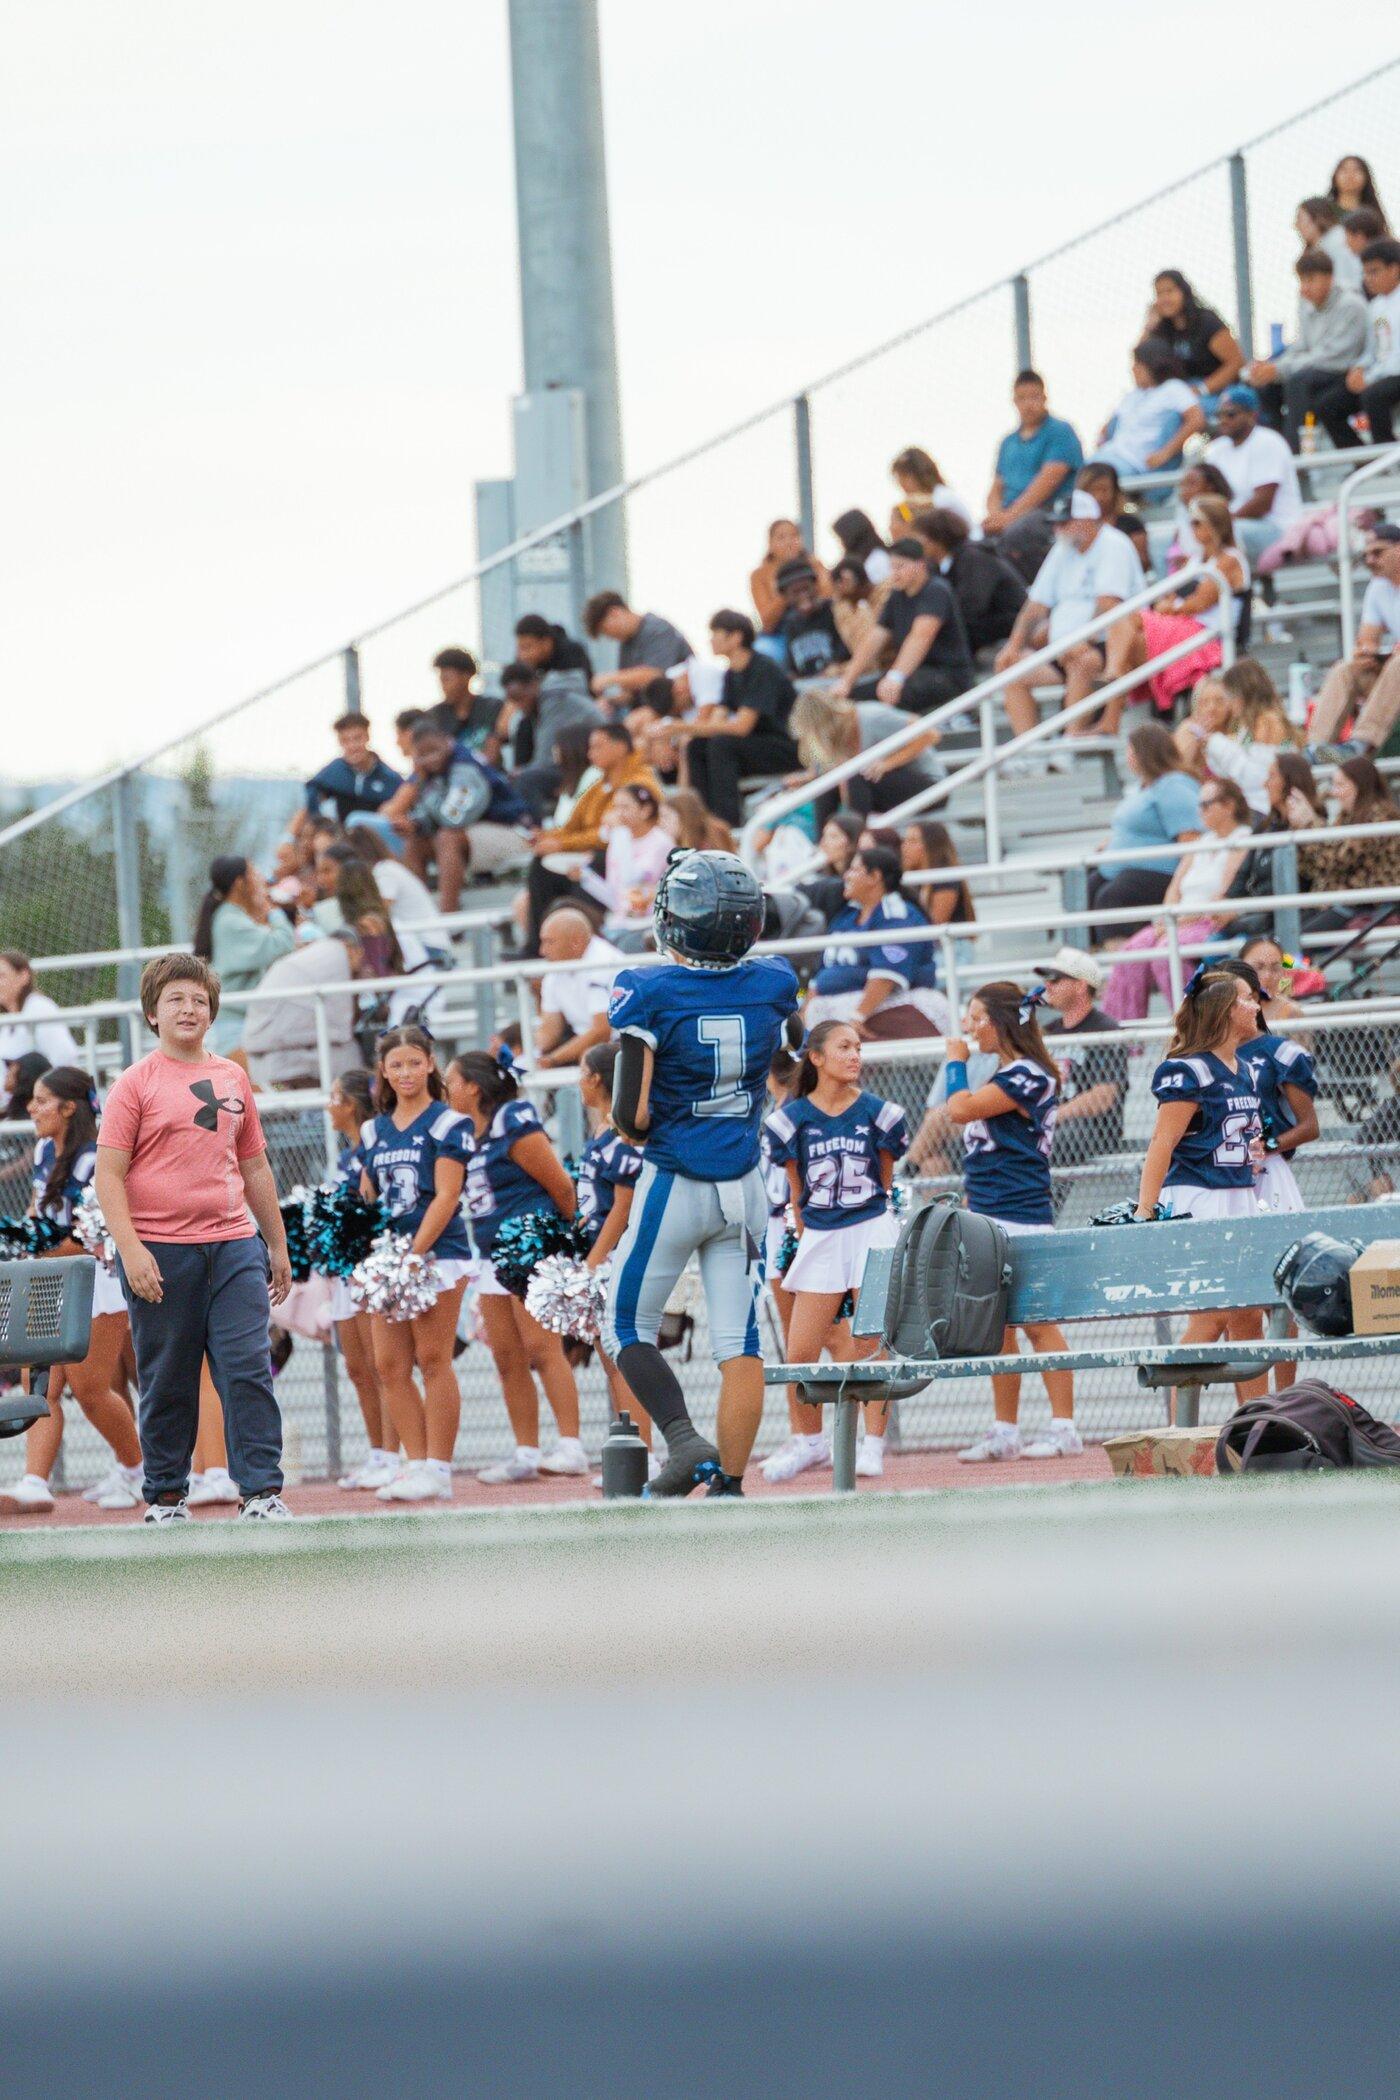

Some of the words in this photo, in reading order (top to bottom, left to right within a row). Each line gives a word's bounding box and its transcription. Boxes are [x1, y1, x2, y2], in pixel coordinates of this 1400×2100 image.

[692, 1014, 753, 1118] 1
[808, 1136, 867, 1158] FREEDOM
[805, 1151, 877, 1209] 25
